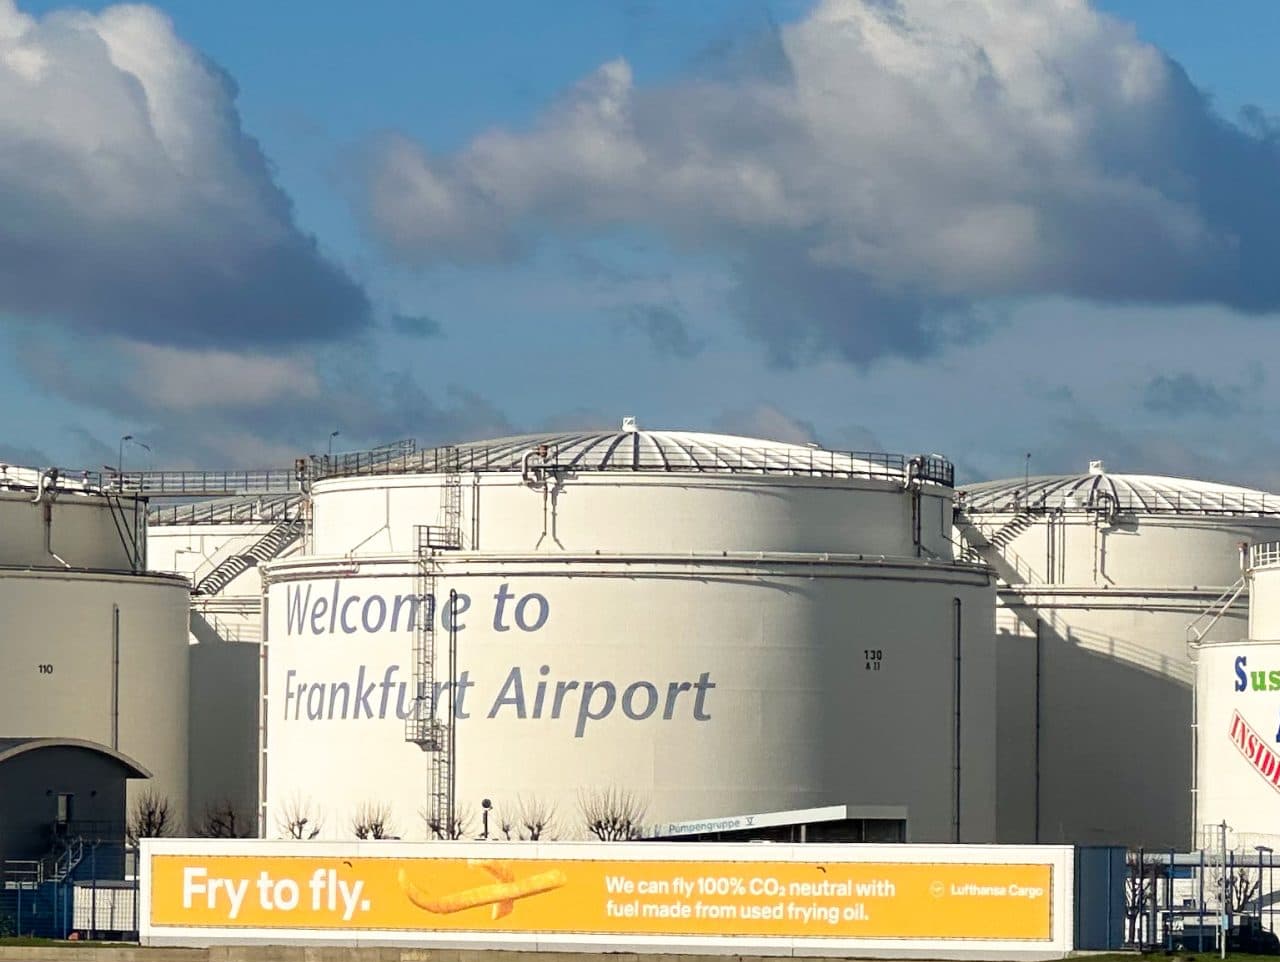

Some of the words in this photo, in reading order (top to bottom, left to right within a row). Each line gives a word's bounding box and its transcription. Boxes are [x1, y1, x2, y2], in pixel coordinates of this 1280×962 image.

[286, 581, 471, 636] Welcome
[492, 582, 550, 633] to
[864, 649, 882, 661] 130
[38, 664, 53, 674] 110
[284, 664, 475, 721] Frankfurt
[488, 665, 716, 738] Airport
[183, 867, 249, 919] Fry
[257, 871, 300, 910] to
[309, 868, 372, 921] fly.
[606, 876, 634, 894] We
[637, 878, 669, 894] can
[672, 876, 695, 898] fly
[699, 877, 746, 896] 100%
[789, 880, 851, 897] neutral
[856, 880, 896, 897] with
[950, 884, 1007, 897] Lufthansa
[1008, 884, 1043, 899] Cargo
[607, 900, 638, 917] fuel
[642, 902, 691, 919] made
[695, 902, 737, 919] from
[740, 902, 784, 920] used
[788, 902, 840, 924] frying
[843, 904, 869, 921] oil.
